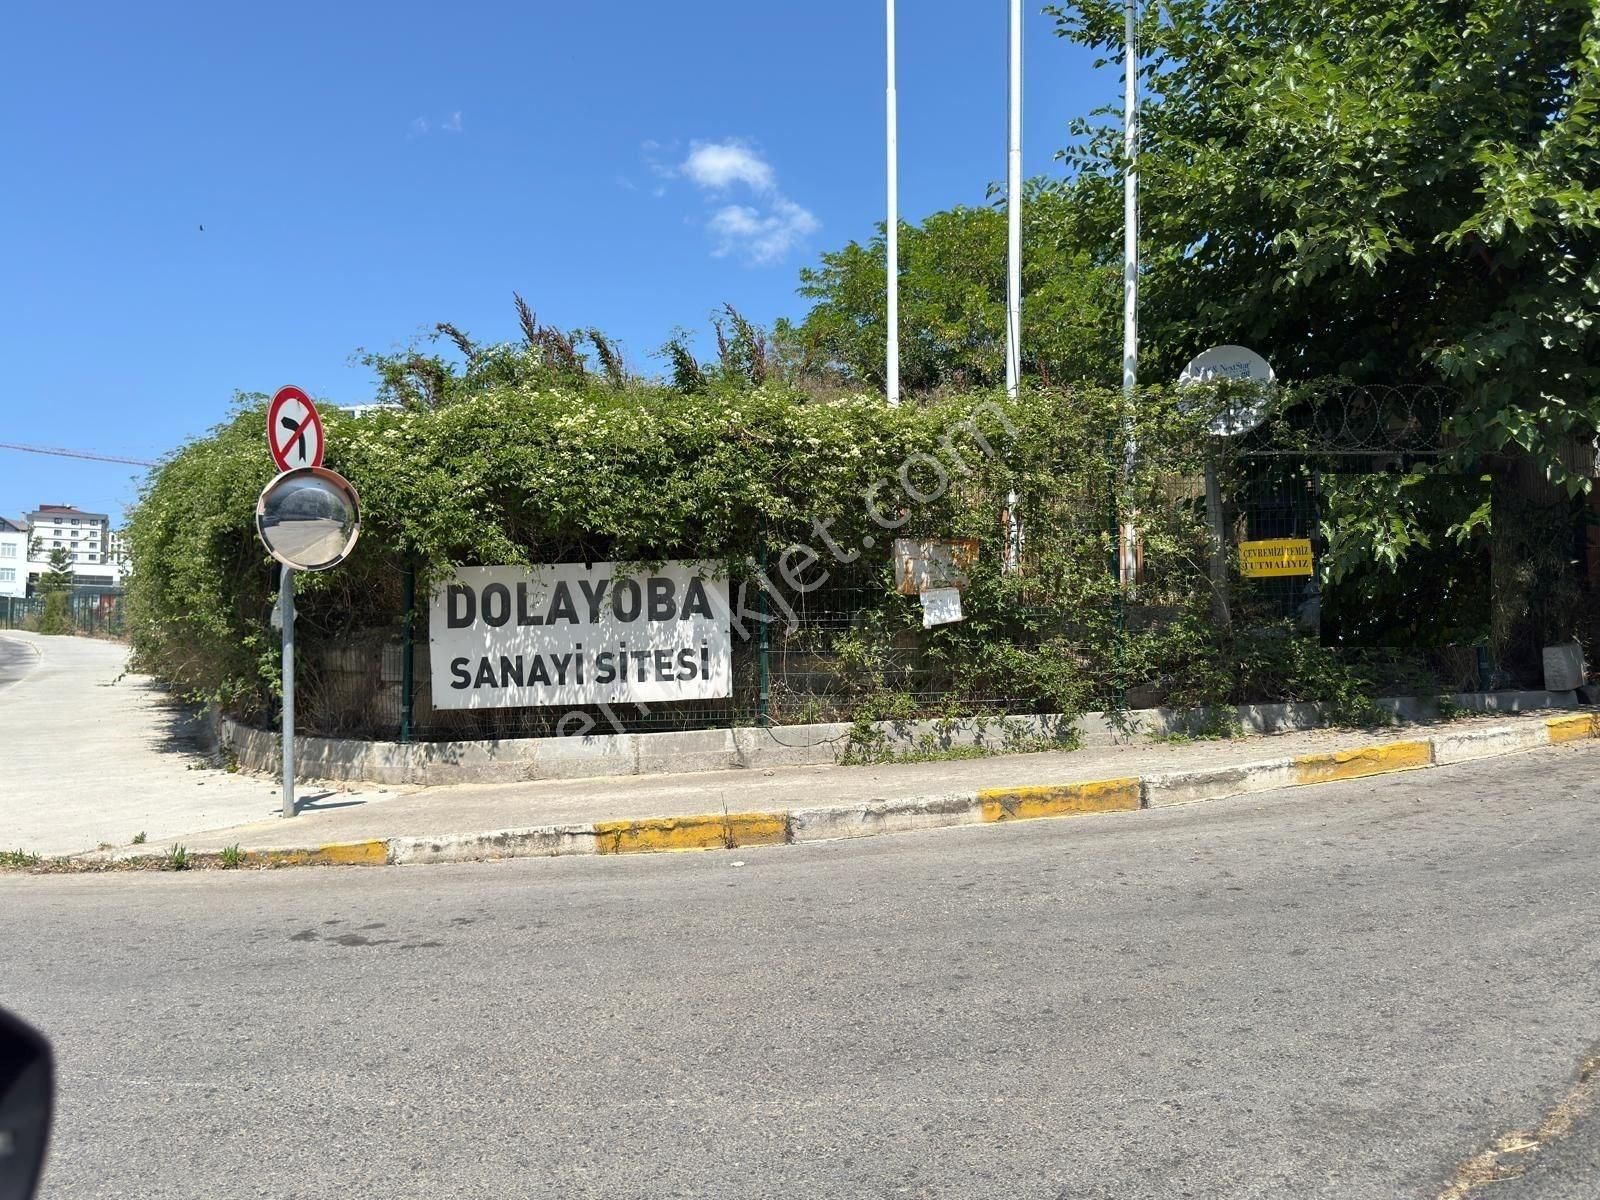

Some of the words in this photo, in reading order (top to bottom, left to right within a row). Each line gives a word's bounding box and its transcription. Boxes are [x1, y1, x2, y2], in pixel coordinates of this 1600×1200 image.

[1243, 560, 1309, 570] TUTMALIYIZ
[447, 577, 714, 628] DOLAYOBA
[450, 643, 584, 690] SANAYİ
[595, 638, 709, 684] SİTESİ
